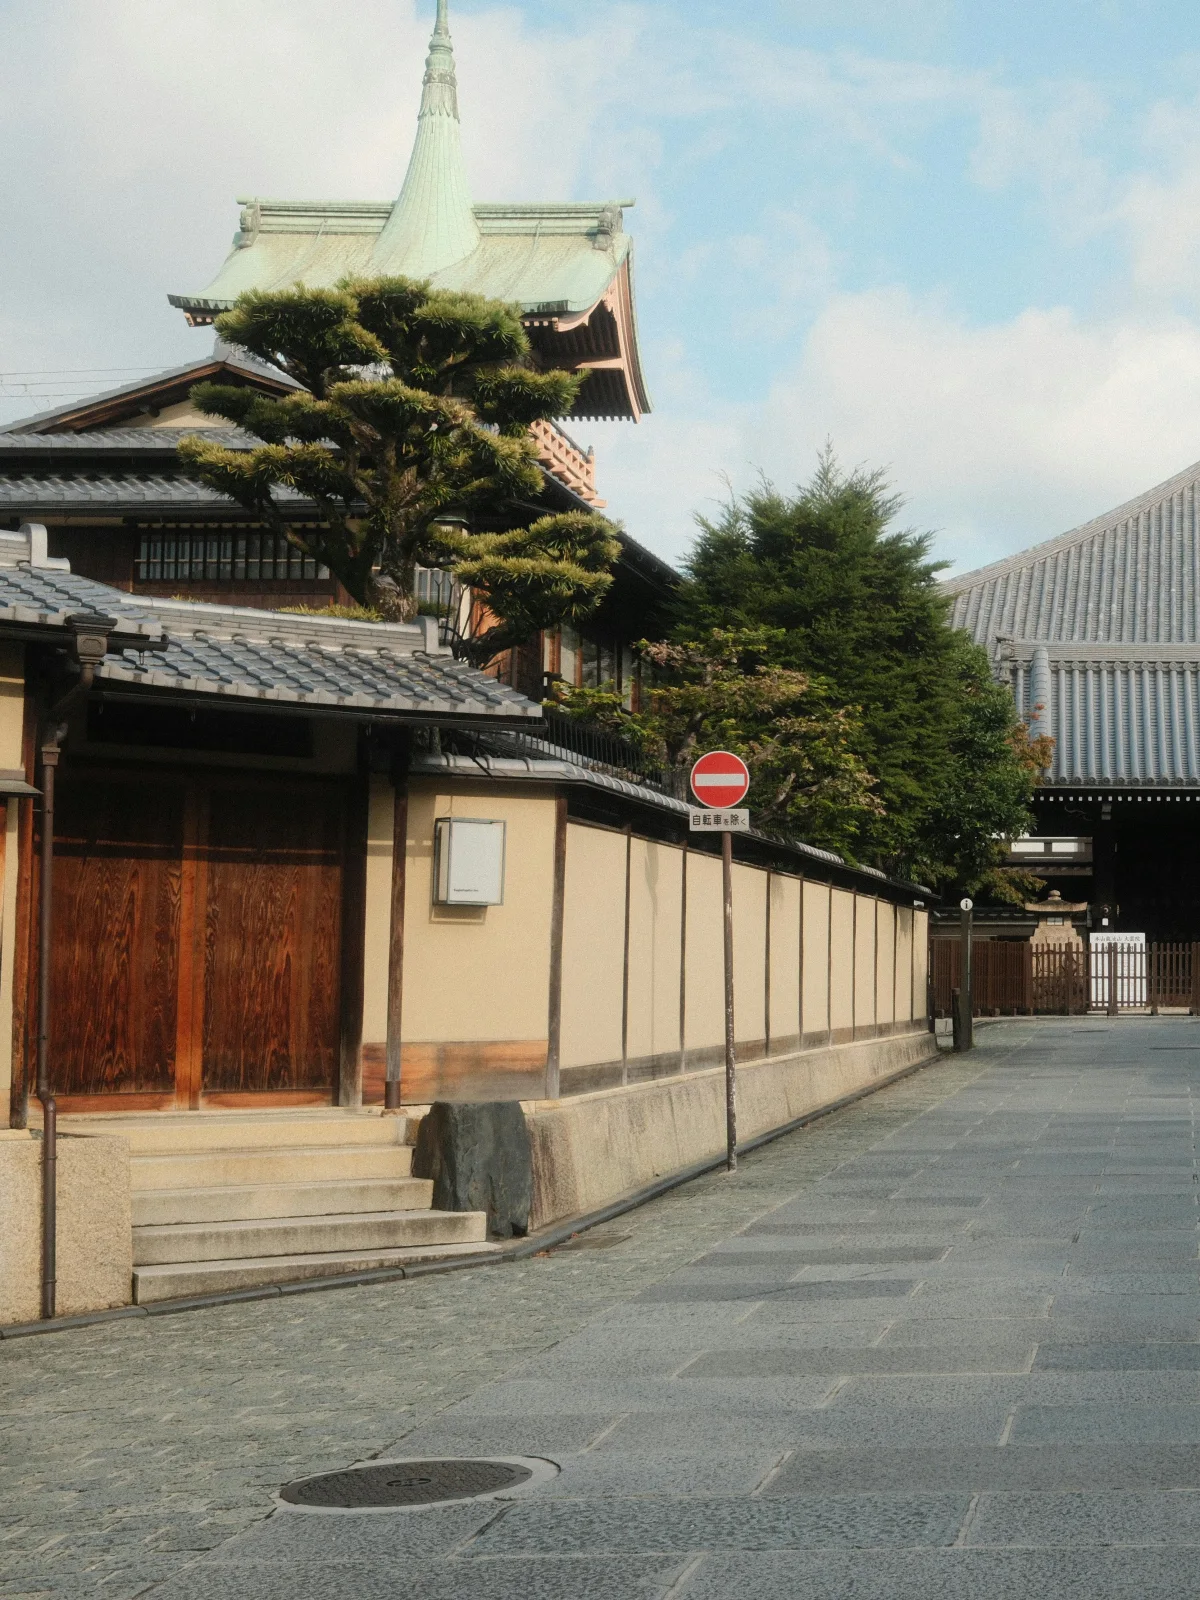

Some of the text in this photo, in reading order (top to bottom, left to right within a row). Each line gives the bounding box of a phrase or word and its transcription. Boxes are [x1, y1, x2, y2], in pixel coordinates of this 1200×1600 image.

[692, 814, 747, 826] 自転車を除く
